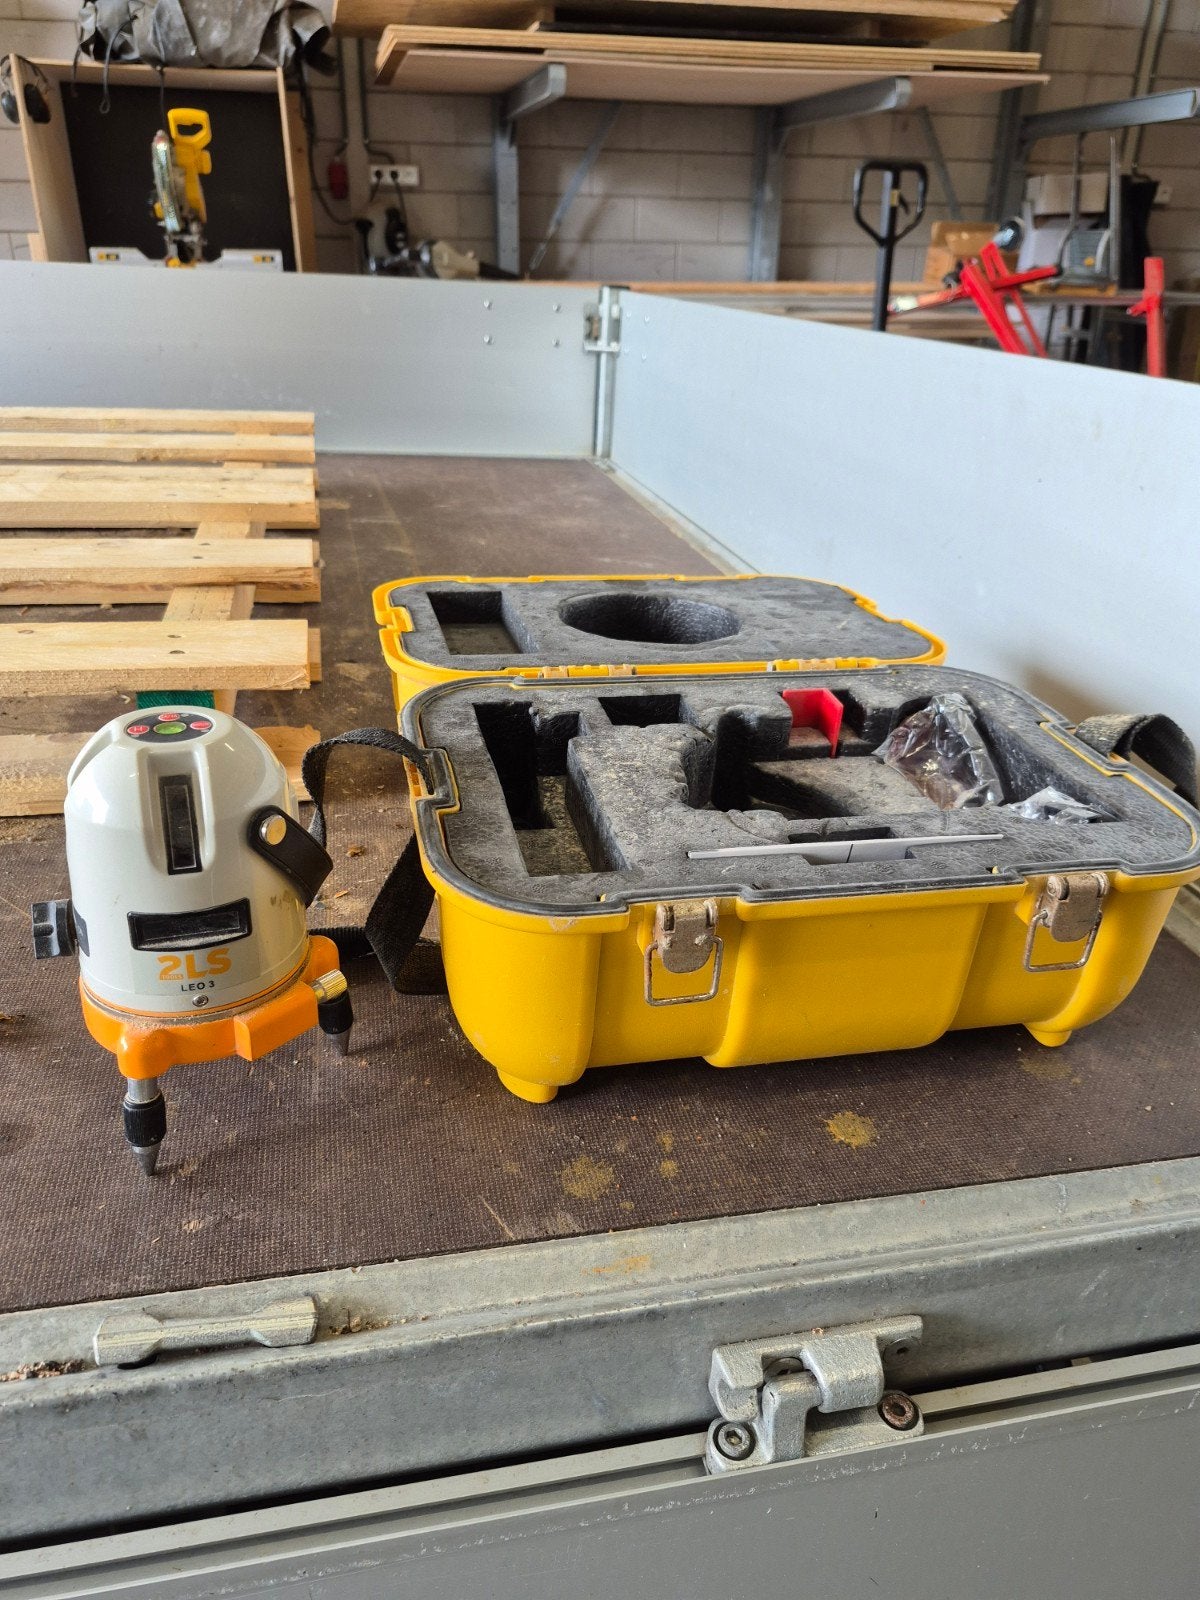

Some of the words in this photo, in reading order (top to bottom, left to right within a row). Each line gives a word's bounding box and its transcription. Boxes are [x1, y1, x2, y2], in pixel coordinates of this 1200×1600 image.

[157, 947, 232, 980] 2LS
[181, 982, 206, 992] LEO
[208, 980, 215, 988] 3
